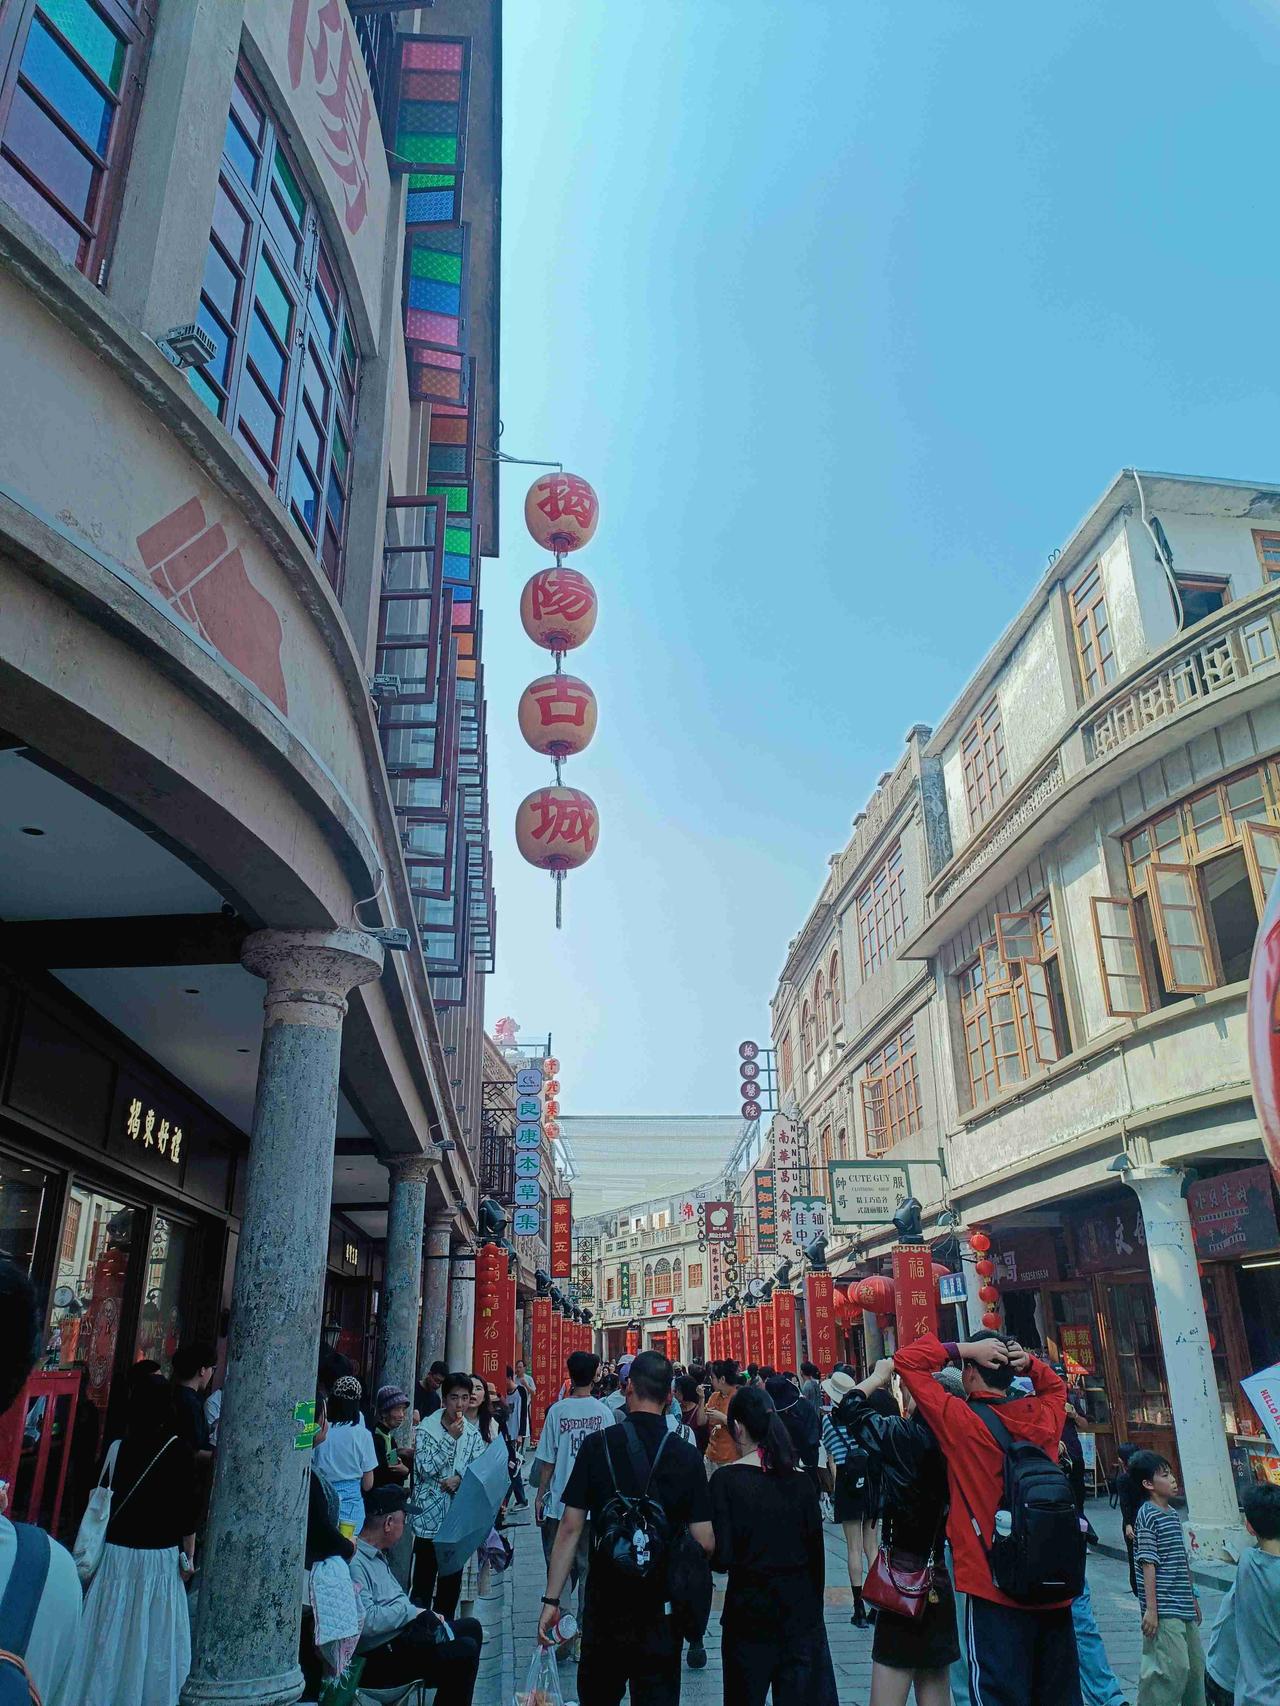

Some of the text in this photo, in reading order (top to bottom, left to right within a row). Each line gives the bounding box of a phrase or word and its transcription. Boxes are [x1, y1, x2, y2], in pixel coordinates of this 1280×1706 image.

[531, 475, 598, 853] 揭陽古城
[516, 1101, 540, 1230] 良康本草集
[848, 1174, 891, 1183] CUTE GUY
[554, 1204, 568, 1272] 華誠五金
[1260, 1389, 1279, 1414] HELLO
